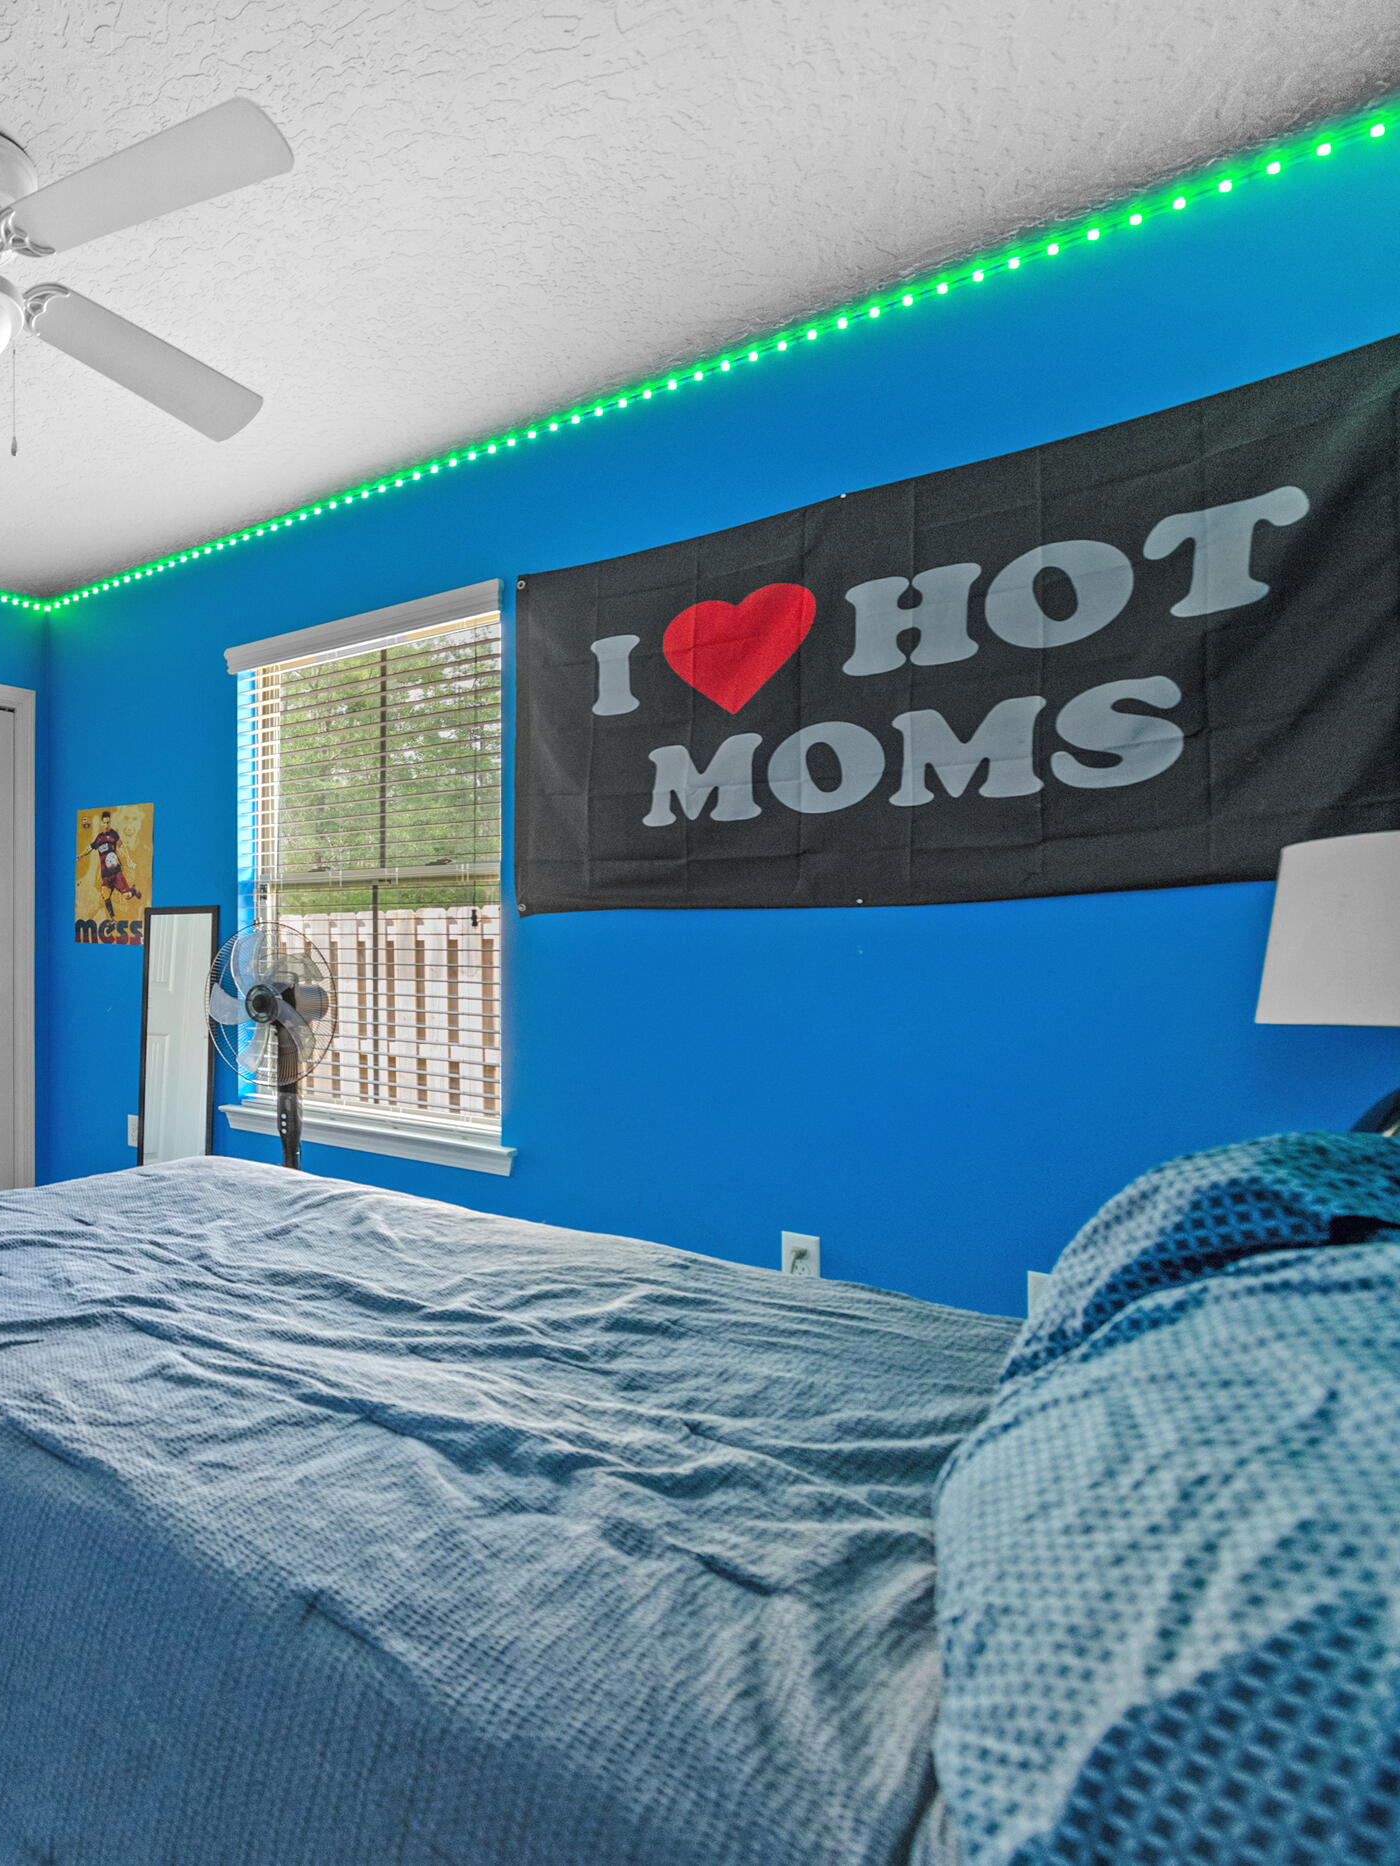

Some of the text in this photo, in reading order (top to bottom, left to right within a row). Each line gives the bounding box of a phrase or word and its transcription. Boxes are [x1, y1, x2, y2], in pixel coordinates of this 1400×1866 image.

[590, 485, 1311, 717] I HOT
[642, 675, 1185, 827] MOMS
